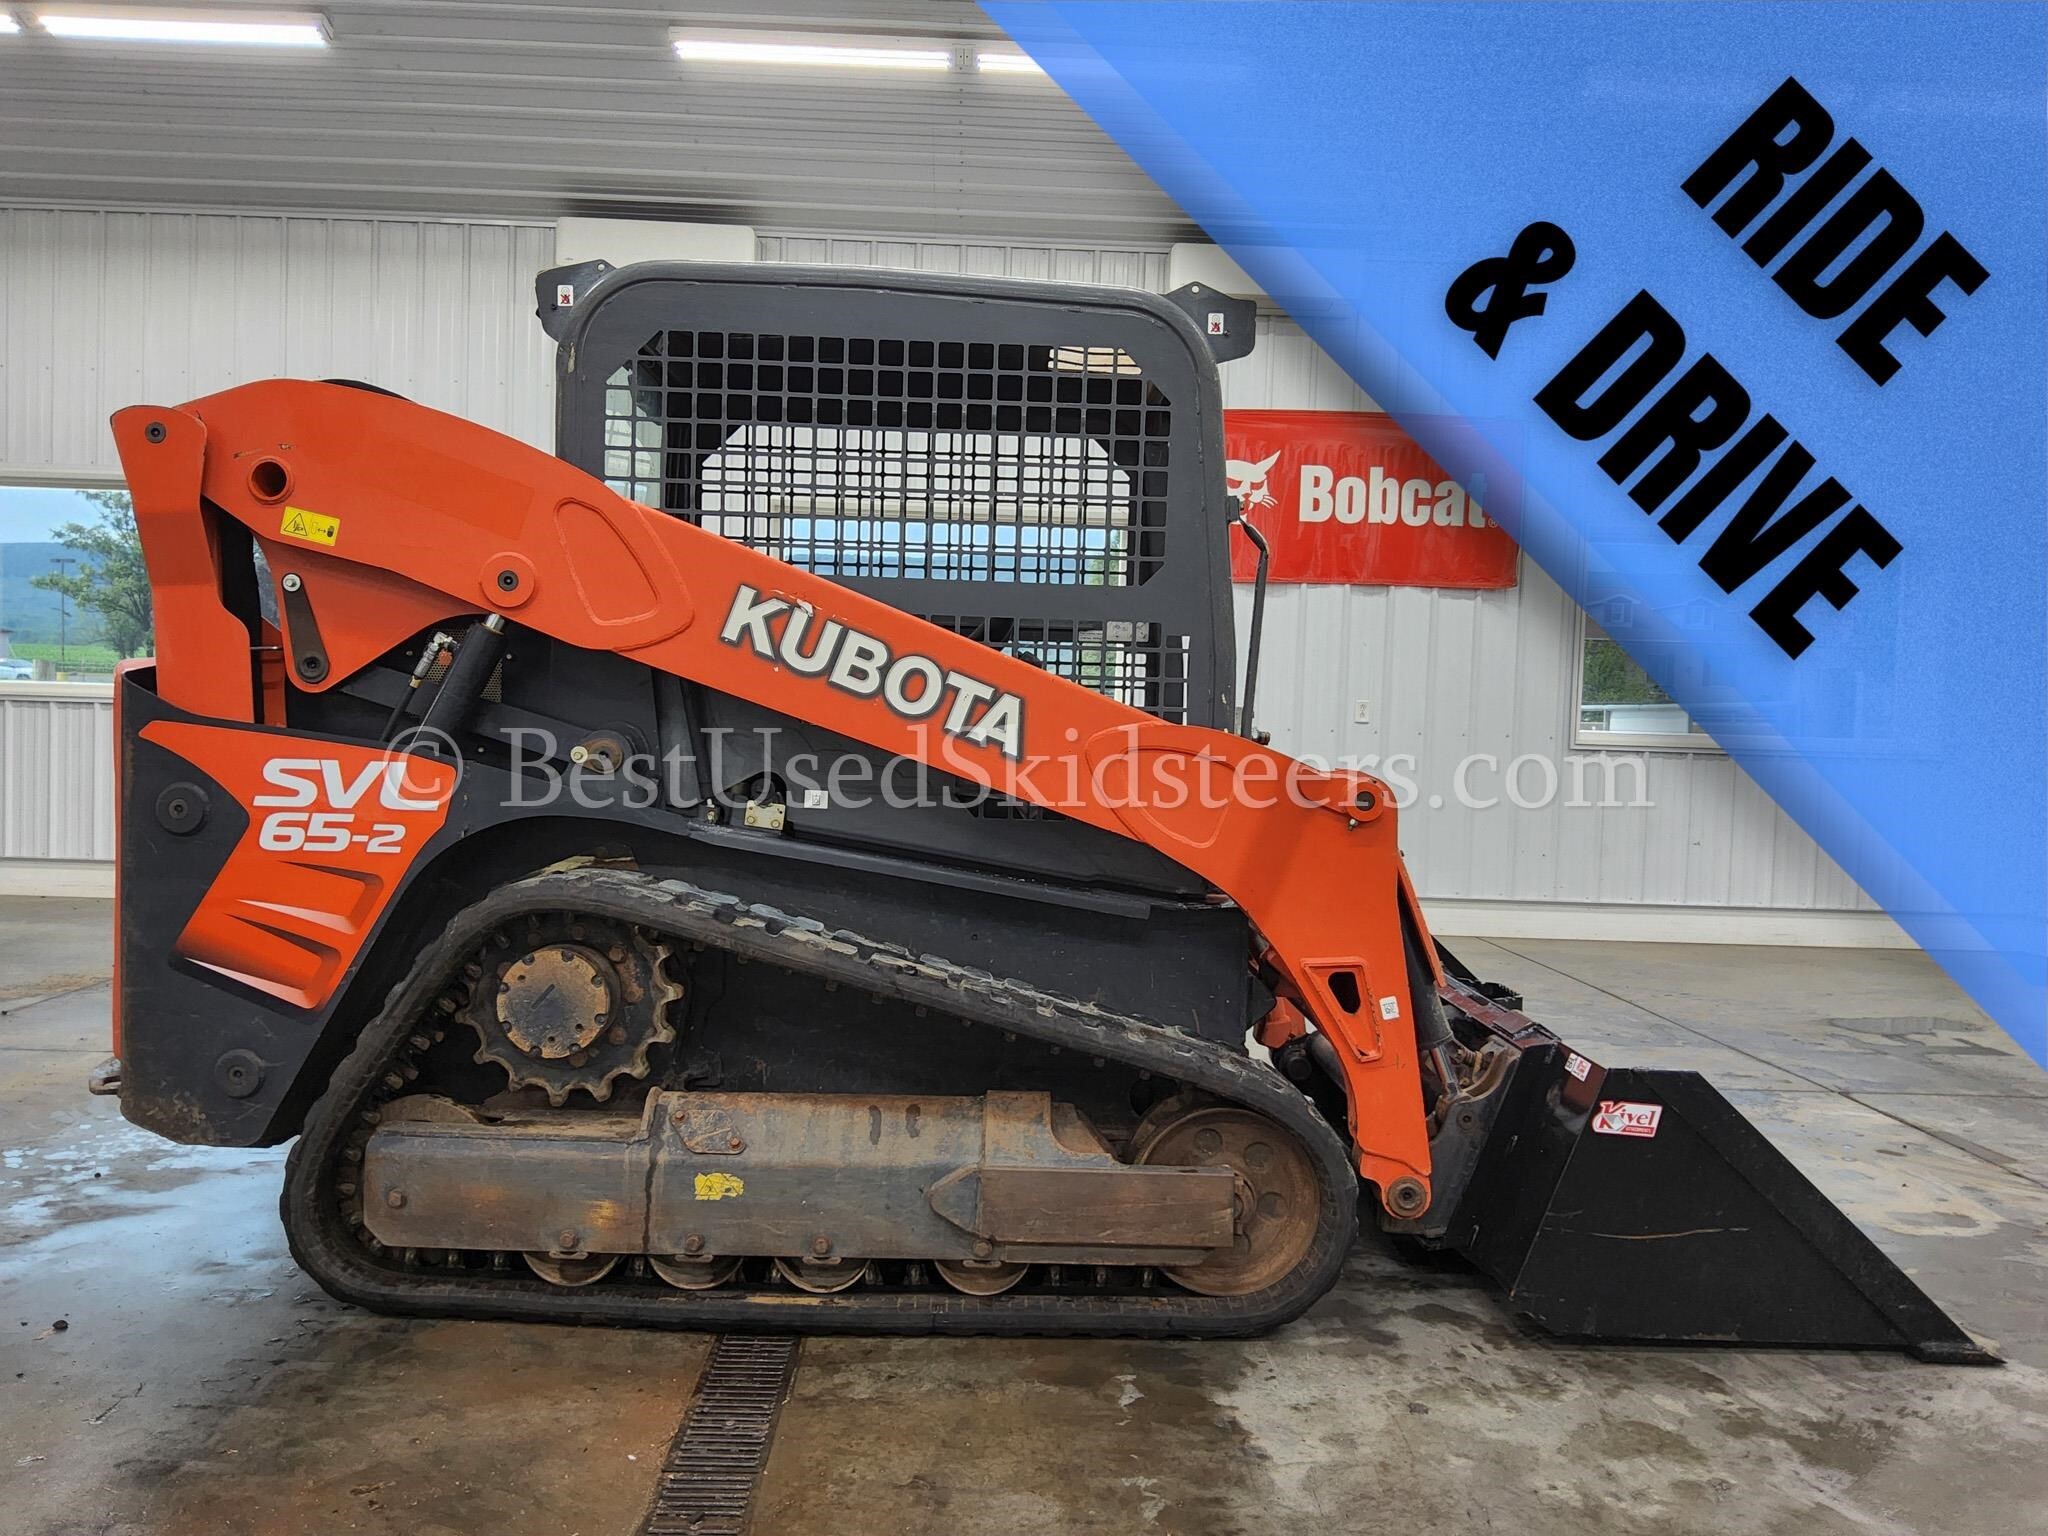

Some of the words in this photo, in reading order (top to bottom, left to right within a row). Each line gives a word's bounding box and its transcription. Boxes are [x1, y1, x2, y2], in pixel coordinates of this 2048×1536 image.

[720, 583, 1023, 759] KUBOTA
[253, 758, 440, 811] SVL
[258, 812, 406, 854] 65-2
